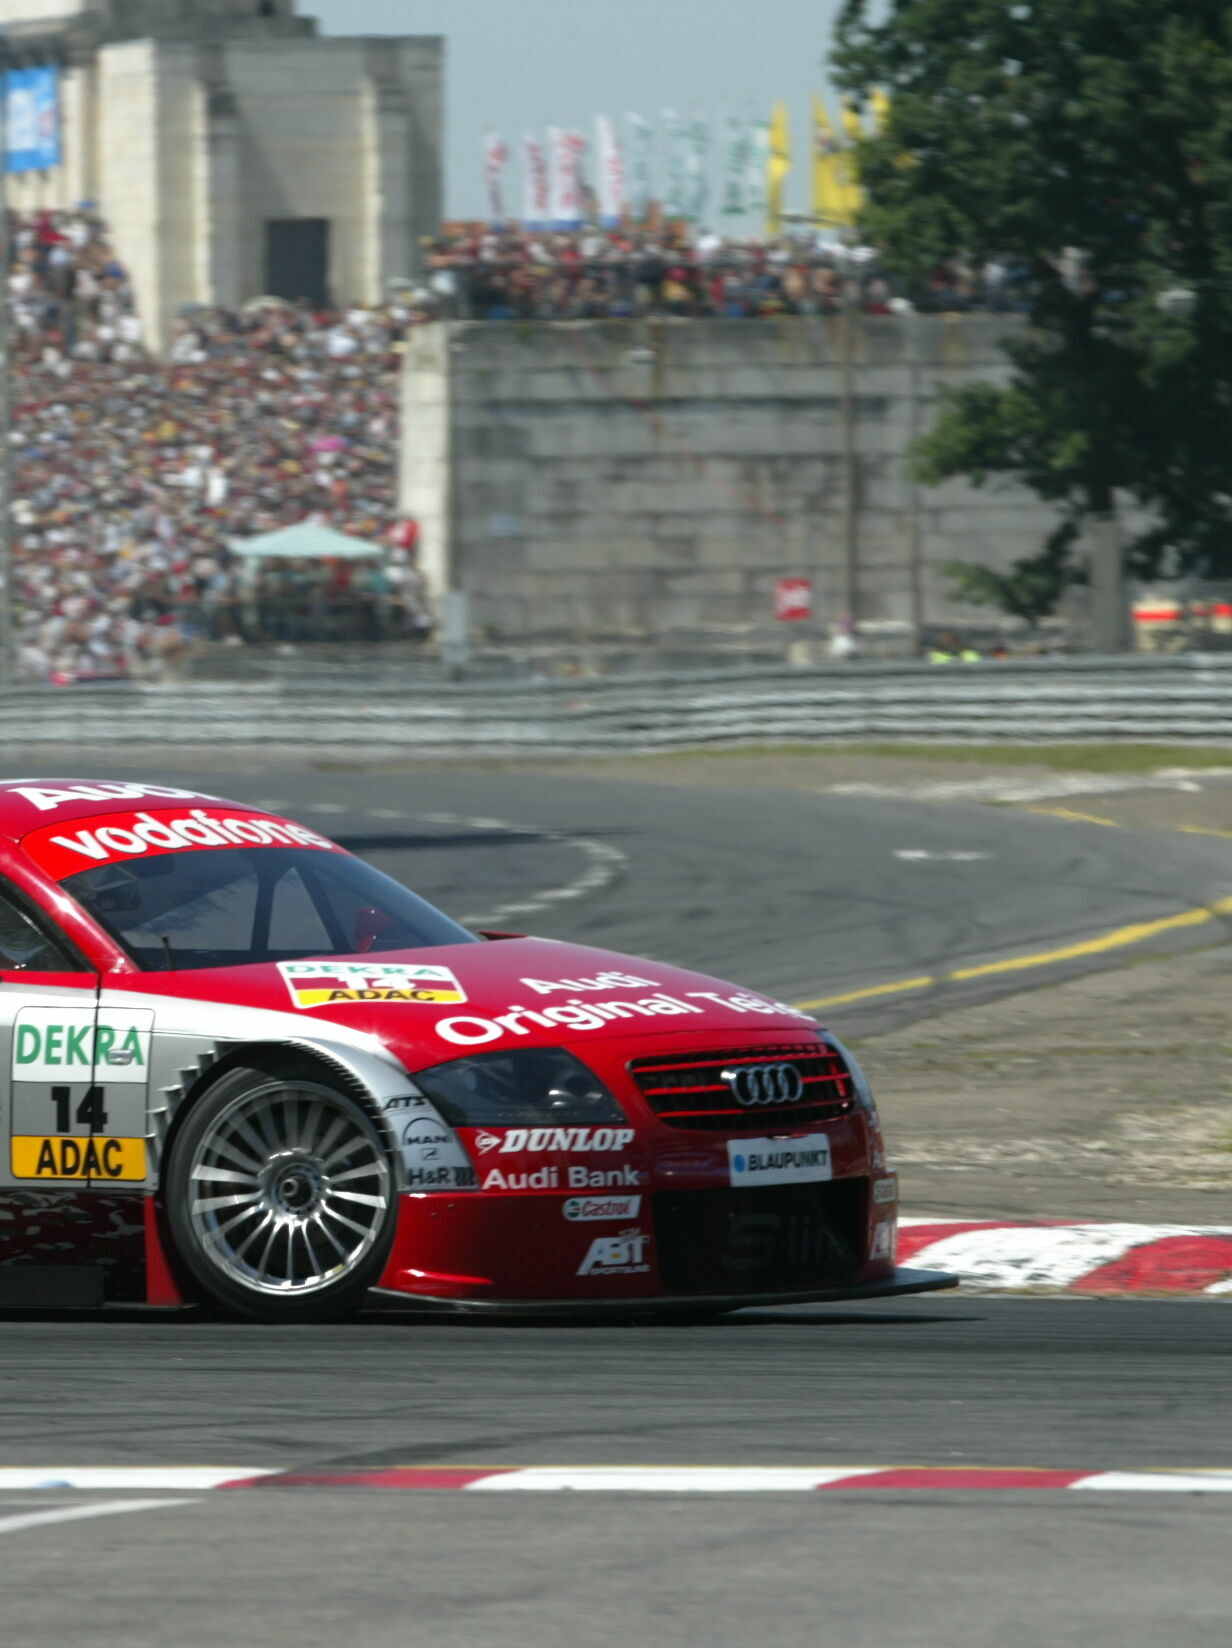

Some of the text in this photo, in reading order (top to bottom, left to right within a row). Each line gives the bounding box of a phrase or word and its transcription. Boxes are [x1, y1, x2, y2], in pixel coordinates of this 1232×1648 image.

[49, 809, 333, 860] vodafone
[285, 965, 445, 977] DEKRA
[519, 971, 661, 994] Audi
[328, 990, 436, 1001] ADAC
[435, 993, 705, 1045] Original
[16, 1024, 145, 1066] DEKRA
[51, 1086, 107, 1133] 14
[499, 1128, 635, 1153] DUNLOP
[36, 1139, 123, 1177] ADAC
[747, 1150, 828, 1172] BLAUPUNKT
[482, 1165, 640, 1190] Audi Bank
[576, 1236, 647, 1275] ABT
